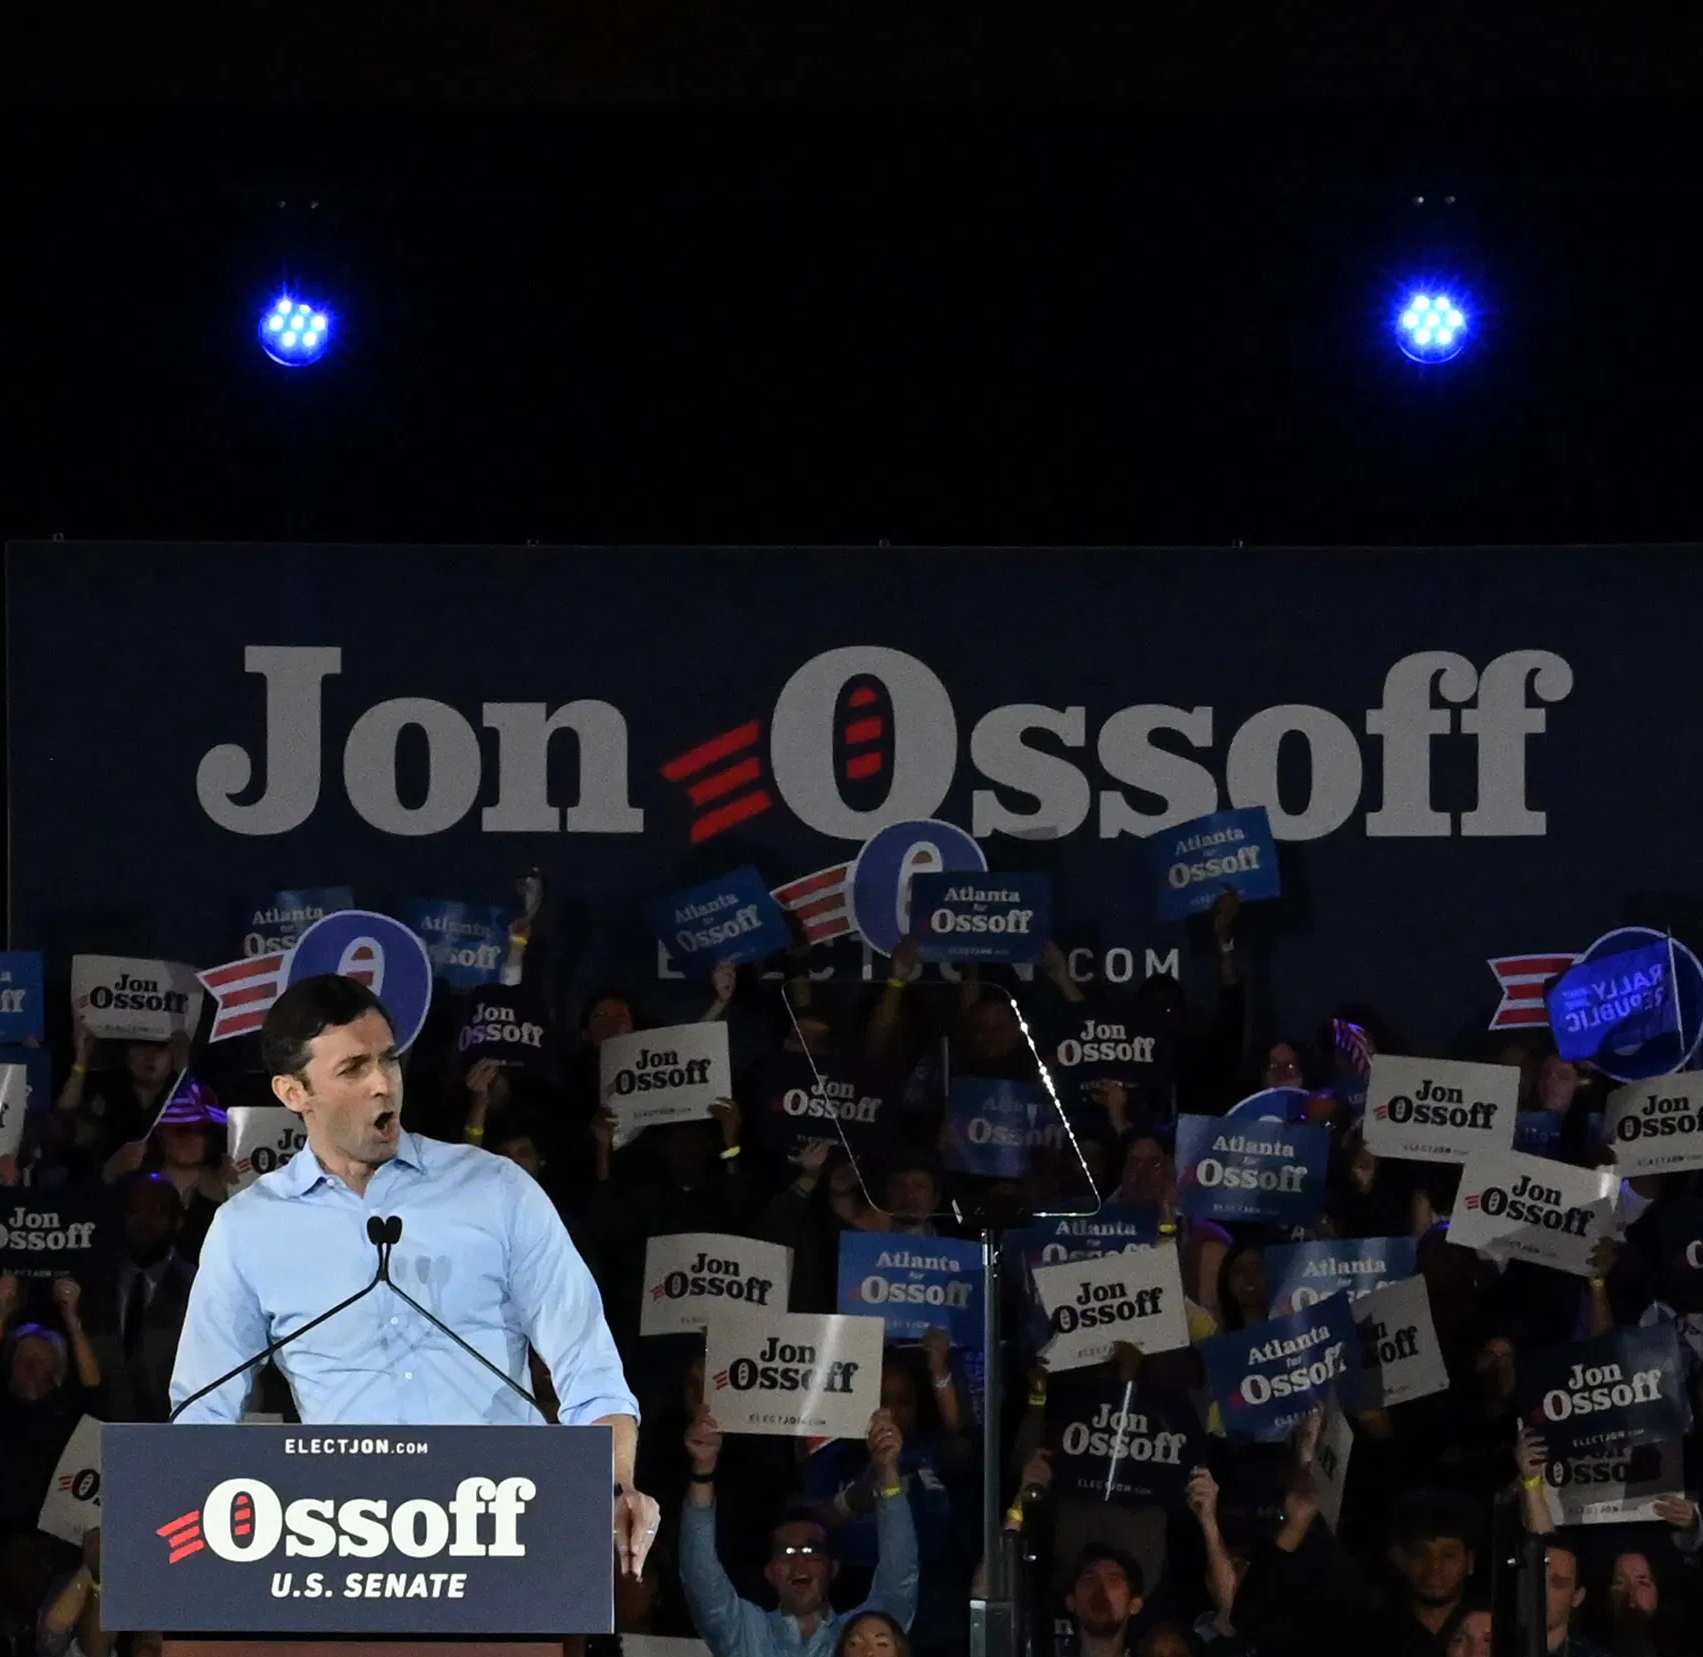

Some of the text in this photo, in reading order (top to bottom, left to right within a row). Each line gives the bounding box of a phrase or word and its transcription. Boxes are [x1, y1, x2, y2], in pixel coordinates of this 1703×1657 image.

[195, 644, 1575, 843] Jon Ossoff
[1172, 825, 1246, 856] Atlanta
[1167, 844, 1261, 889] Ossoff
[943, 885, 1021, 903] Atlanta
[675, 904, 764, 953] Ossoff
[929, 907, 1034, 936] Ossoff
[113, 973, 158, 994] Jon
[89, 986, 188, 1015] Ossoff
[472, 1003, 515, 1025] Jon
[1079, 1019, 1126, 1041] Jon
[634, 1049, 679, 1070] Jon
[1056, 1034, 1155, 1068] Ossoff
[614, 1059, 711, 1096] Ossoff
[1414, 1080, 1464, 1104] Jon
[1386, 1096, 1498, 1130] Ossoff
[1641, 1095, 1690, 1116] Jon
[1211, 1134, 1295, 1157] Atlanta
[1195, 1159, 1308, 1194] Ossoff
[1511, 1174, 1563, 1205] Jon
[8, 1206, 60, 1230] Jon
[1055, 1218, 1138, 1237] Atlanta
[1479, 1188, 1595, 1238] Ossoff
[690, 1251, 740, 1277] Jon
[875, 1249, 961, 1274] Atlanta
[1302, 1257, 1387, 1279] Atlanta
[663, 1270, 772, 1307] Ossoff
[859, 1280, 974, 1309] Ossoff
[1075, 1280, 1126, 1307] Jon
[1052, 1286, 1164, 1334] Ossoff
[759, 1336, 816, 1364] Jon
[1246, 1321, 1333, 1367] Atlanta
[1239, 1342, 1348, 1408] Ossoff
[1567, 1362, 1623, 1391] Jon
[1542, 1368, 1664, 1422] Ossoff
[284, 1438, 429, 1455] ELECTJON.COM
[1061, 1422, 1187, 1466] Ossoff
[201, 1476, 537, 1563] Ossoff
[270, 1572, 467, 1599] U.S. SENATE
